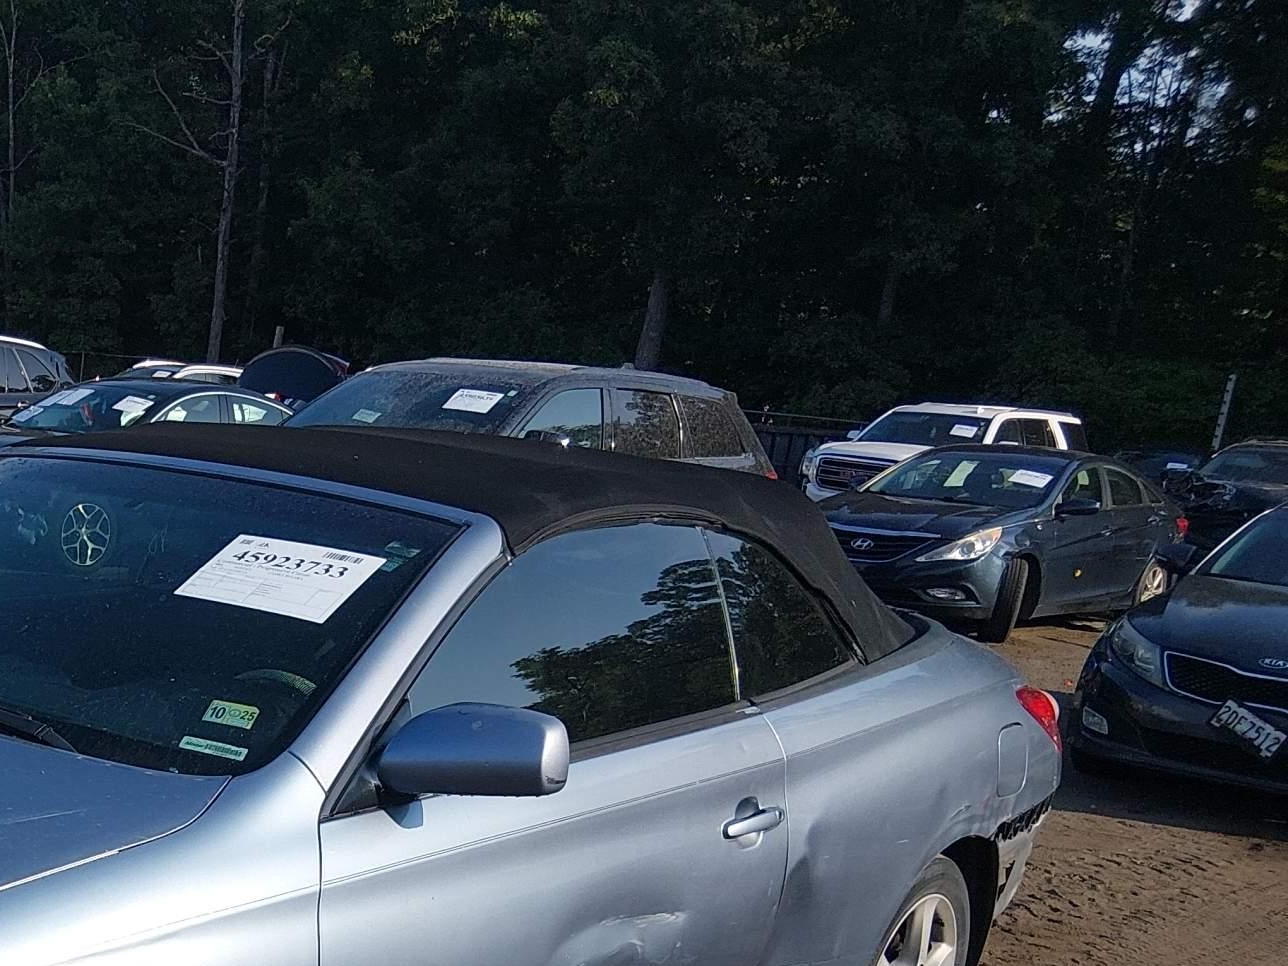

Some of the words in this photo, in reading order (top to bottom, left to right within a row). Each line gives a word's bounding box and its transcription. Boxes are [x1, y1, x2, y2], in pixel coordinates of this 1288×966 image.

[232, 550, 350, 580] 45923733
[1263, 657, 1285, 667] KIA
[208, 705, 227, 720] 10
[239, 710, 257, 722] 25
